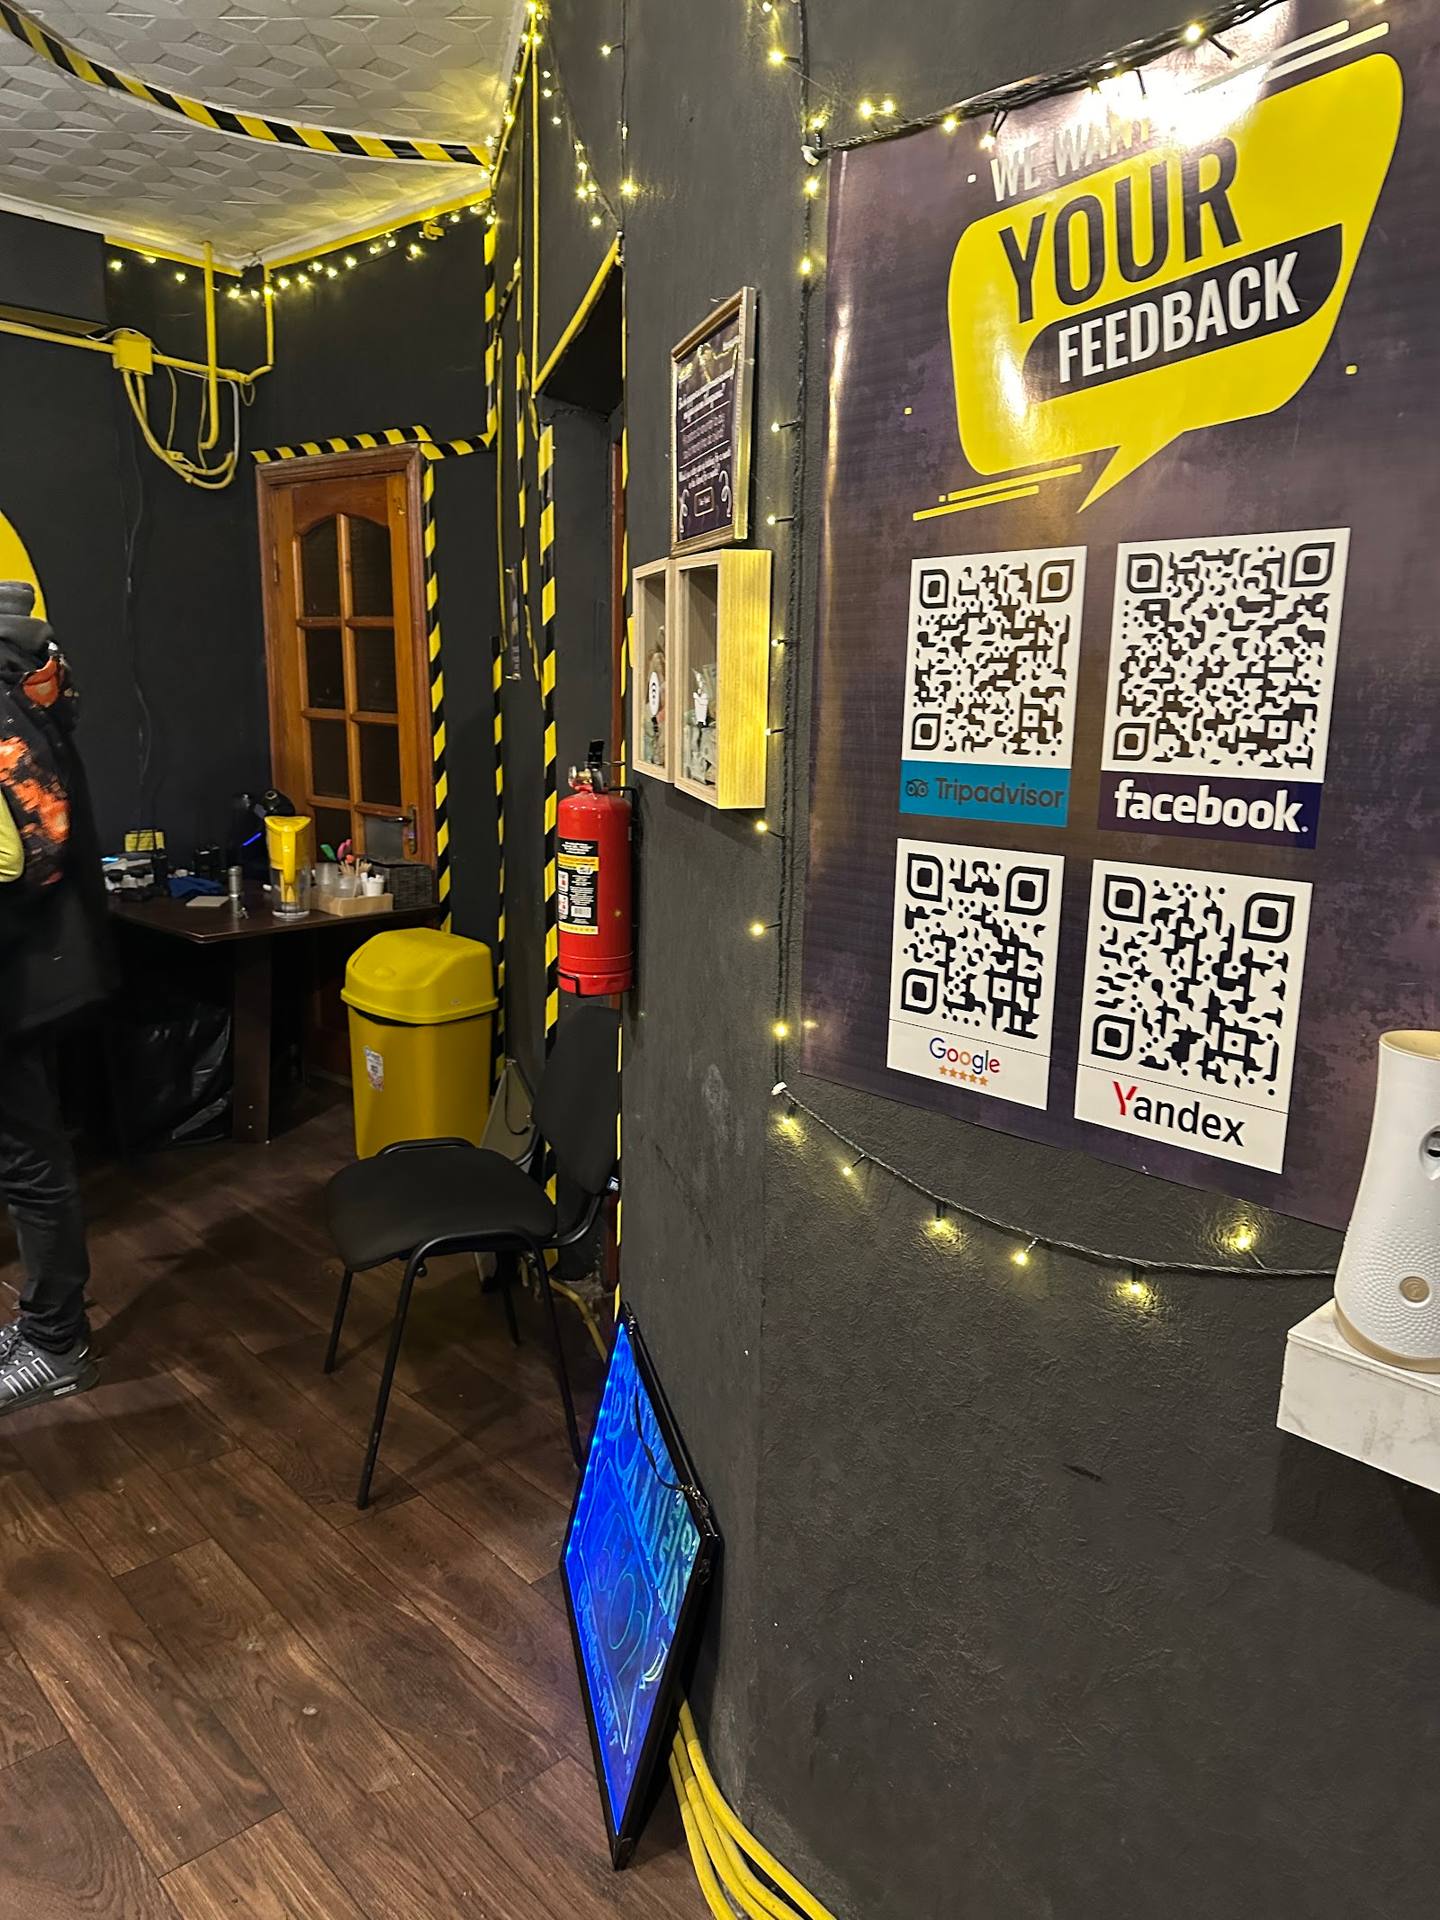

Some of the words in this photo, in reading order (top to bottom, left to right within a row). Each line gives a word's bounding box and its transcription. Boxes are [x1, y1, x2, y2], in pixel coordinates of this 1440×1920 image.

[990, 140, 1042, 201] WE
[998, 136, 1242, 324] YOUR
[1058, 251, 1300, 384] FEEDBACK
[936, 776, 1065, 808] Tripadvisor
[929, 1037, 1001, 1075] Google
[1112, 1080, 1246, 1147] Yandex
